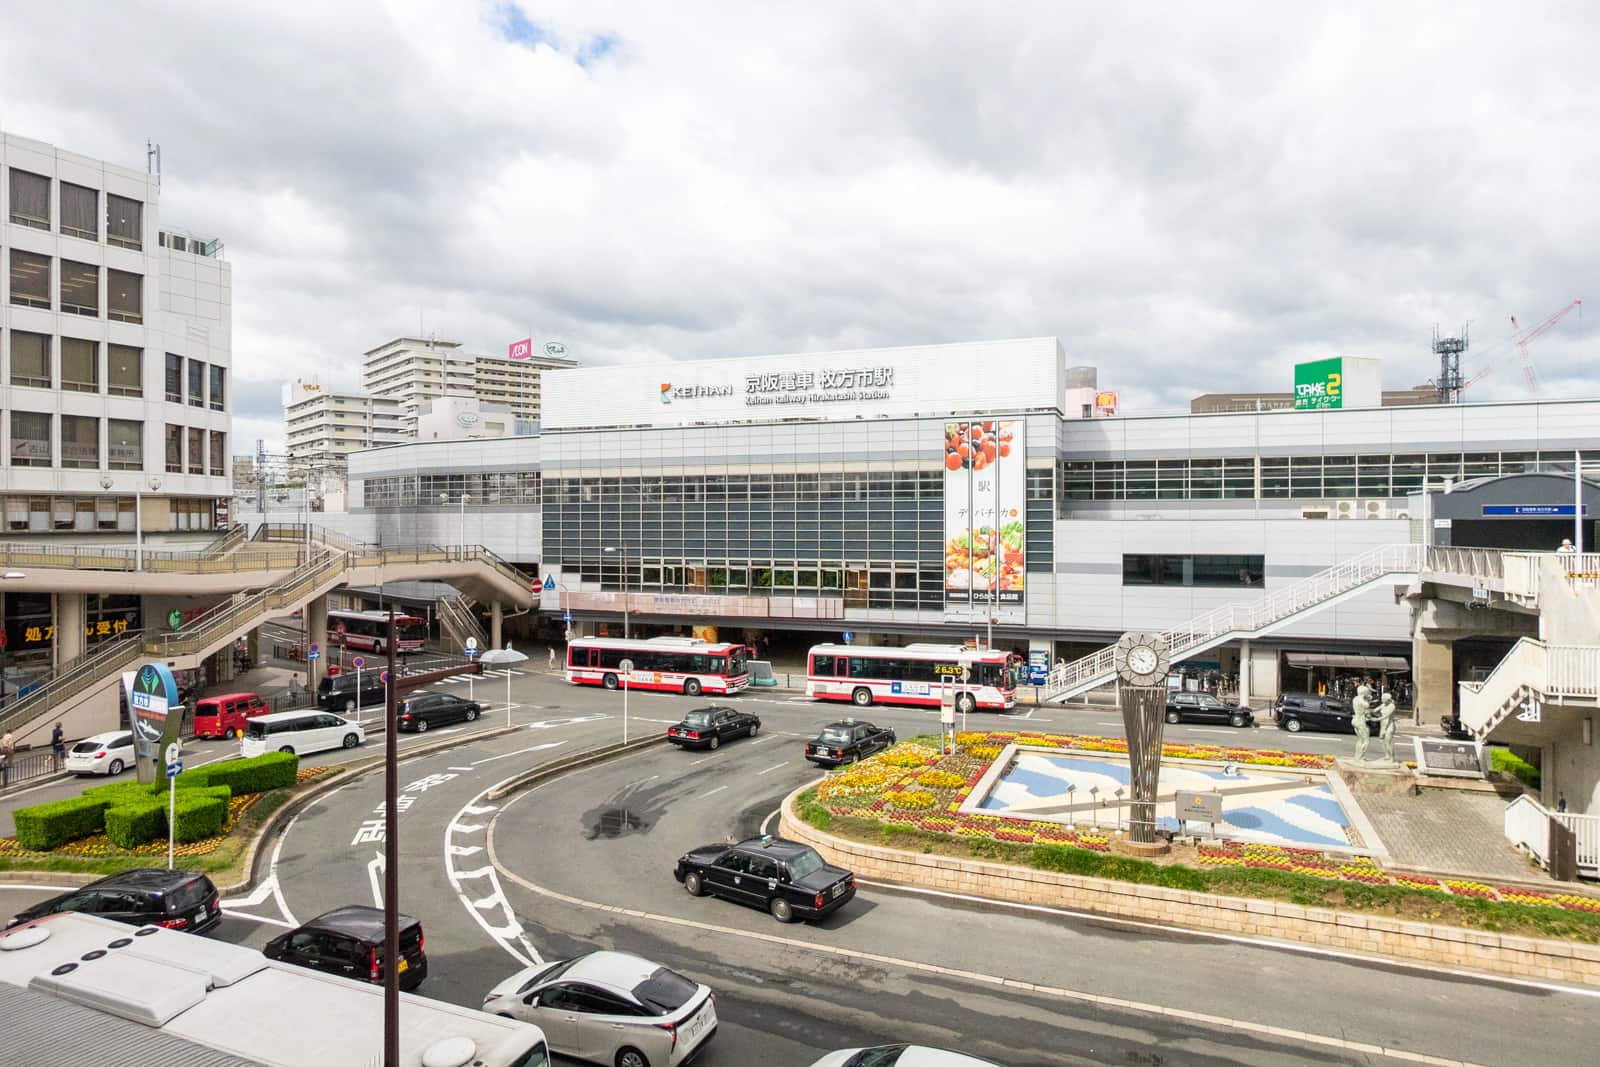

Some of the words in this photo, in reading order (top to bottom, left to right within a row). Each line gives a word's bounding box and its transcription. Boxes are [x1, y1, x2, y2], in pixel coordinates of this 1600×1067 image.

[745, 372, 814, 394] 京阪電車
[820, 366, 894, 389] 枚方市駅
[1296, 382, 1325, 396] TAKE
[1327, 373, 1341, 395] 2
[673, 384, 733, 399] KEIHAN
[745, 395, 774, 406] Keihan
[775, 394, 807, 405] Railway
[859, 390, 890, 401] Station
